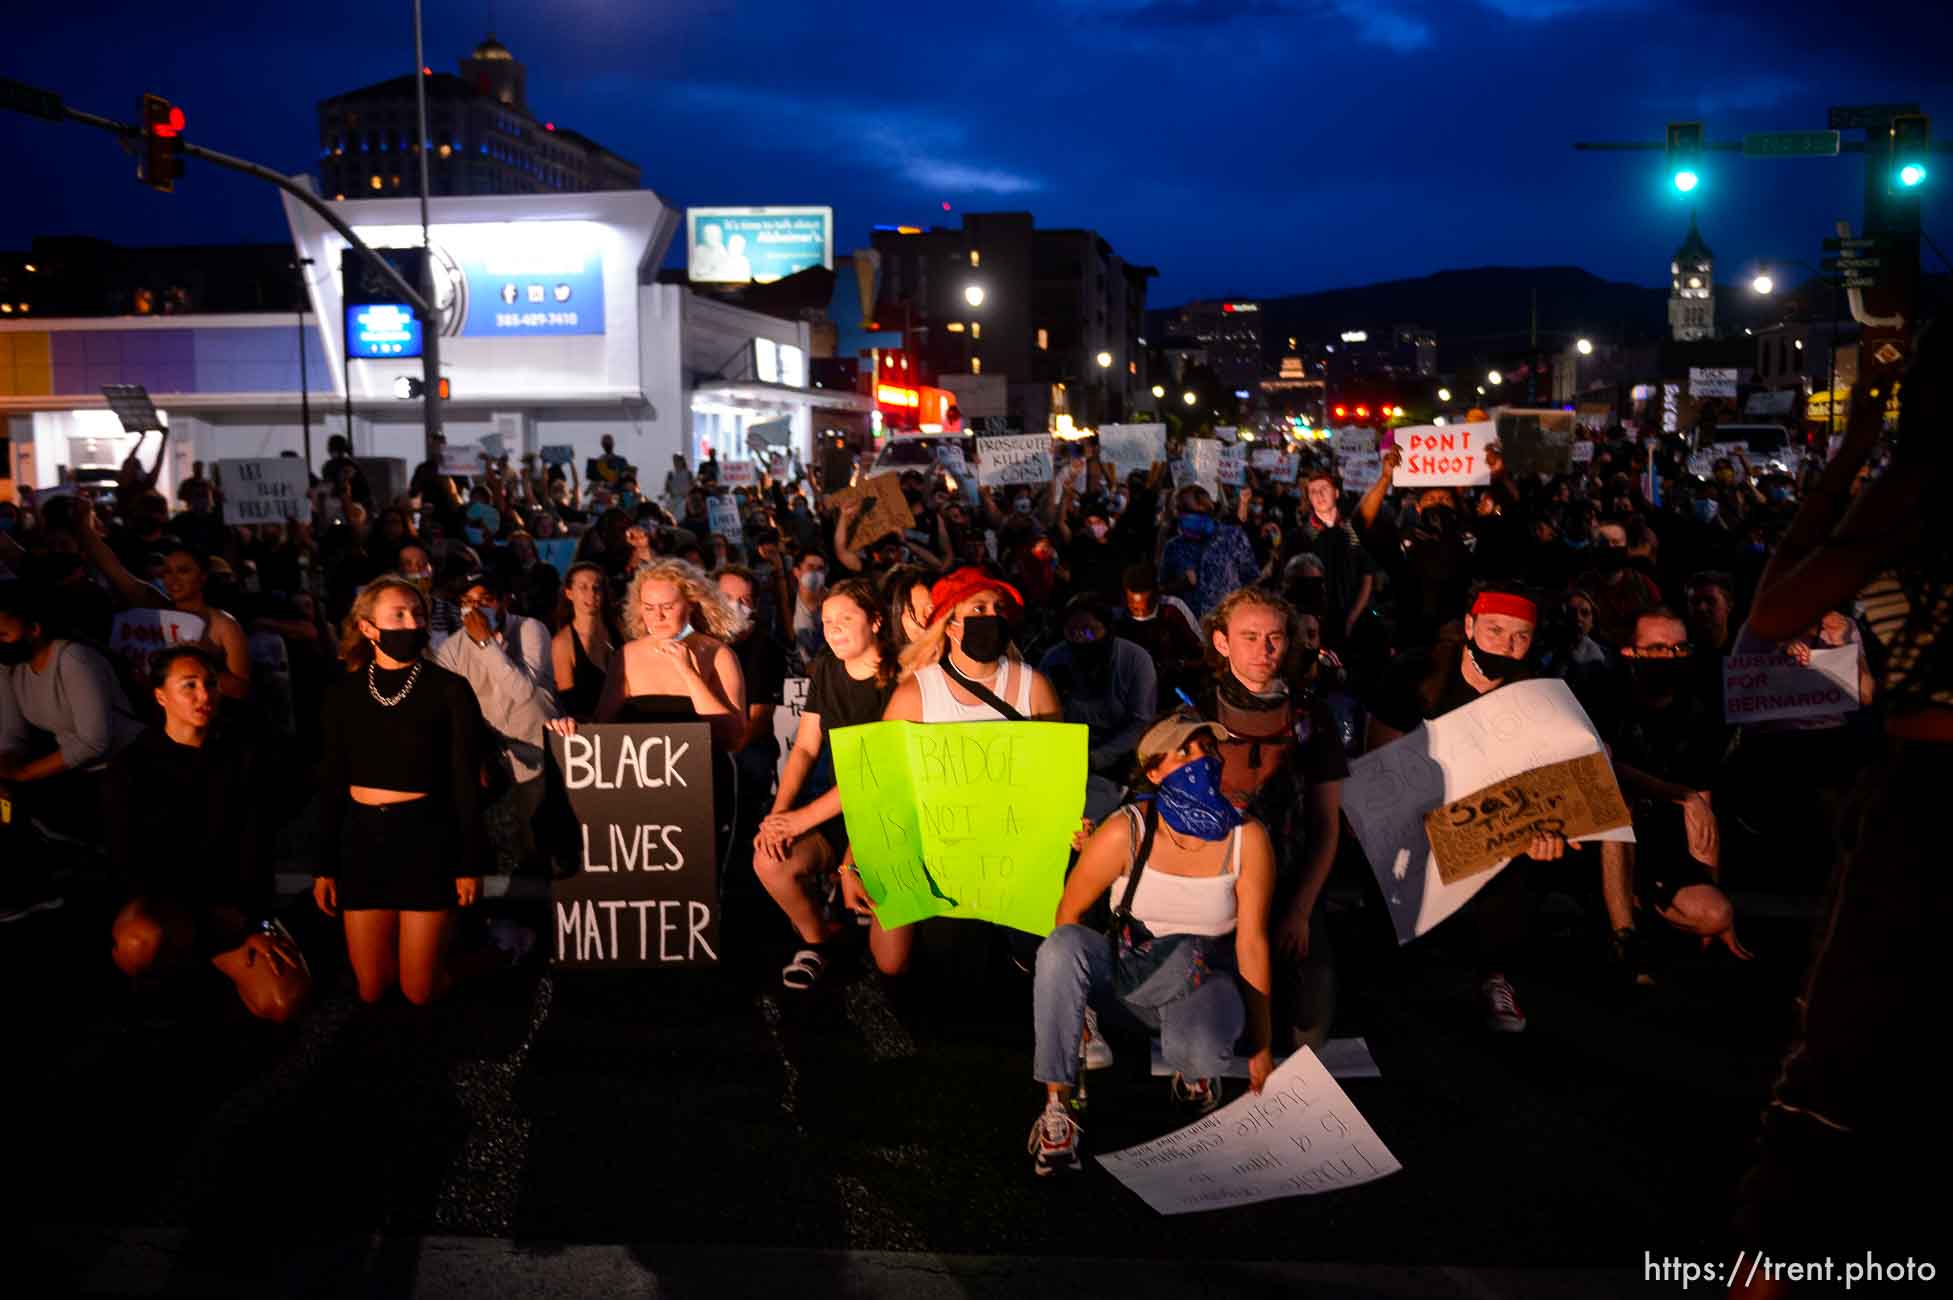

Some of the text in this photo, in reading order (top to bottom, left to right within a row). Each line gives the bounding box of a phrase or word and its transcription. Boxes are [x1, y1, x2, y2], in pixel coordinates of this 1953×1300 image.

[1407, 453, 1474, 475] SHOOT
[1727, 671, 1769, 689] FOR
[1727, 690, 1841, 713] BERNARDO
[563, 733, 690, 790] BLACK
[854, 735, 1023, 791] A BADGE
[921, 799, 977, 836] NOT
[1003, 803, 1020, 836] A
[581, 823, 685, 873] LIVES
[556, 899, 718, 961] MATTER
